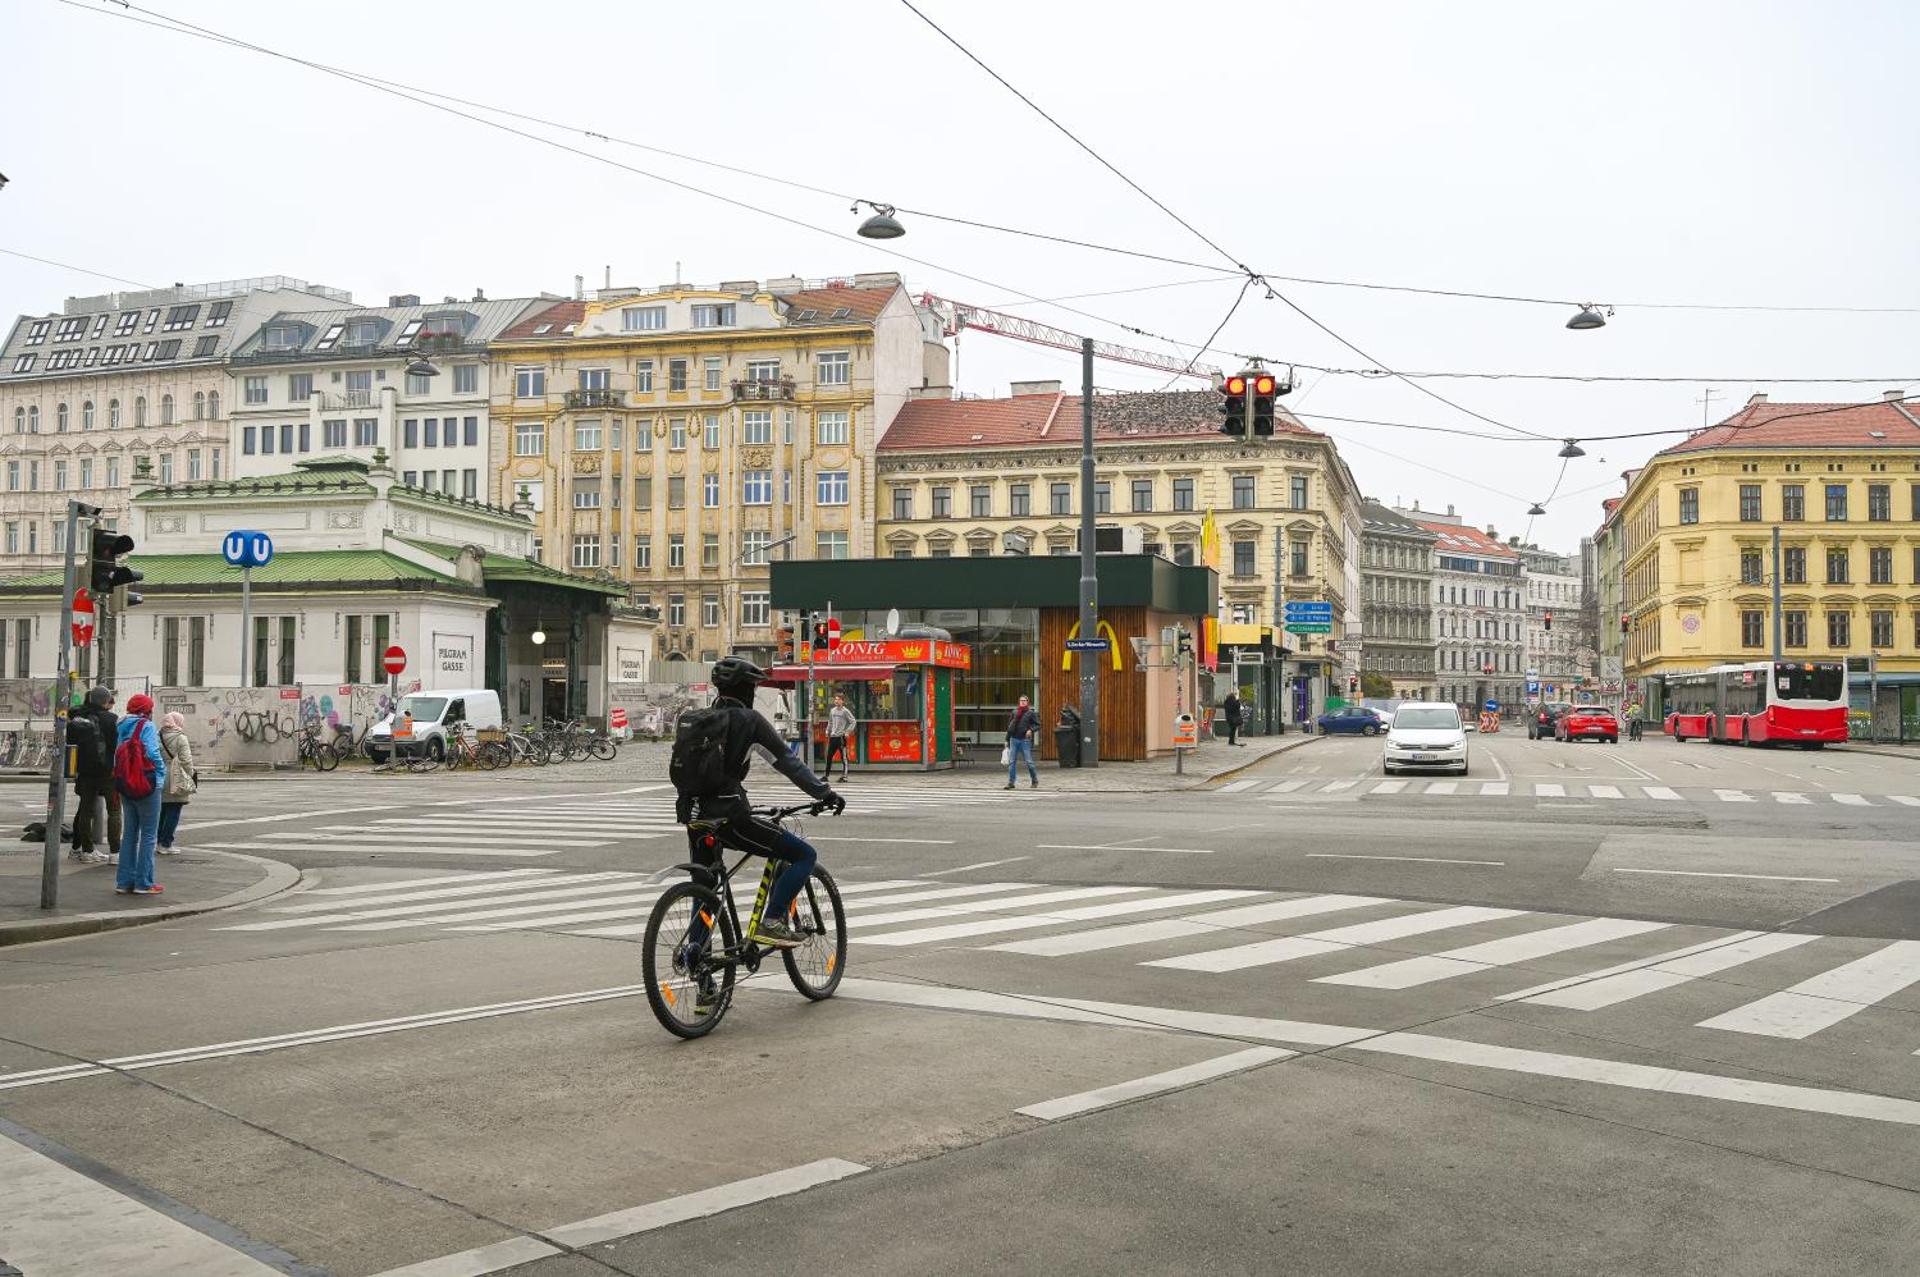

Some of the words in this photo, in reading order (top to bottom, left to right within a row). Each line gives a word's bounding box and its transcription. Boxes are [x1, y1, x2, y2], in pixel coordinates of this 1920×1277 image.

[226, 537, 244, 560] U
[253, 538, 270, 561] U
[438, 648, 467, 660] PILGRAM
[442, 661, 465, 672] GASSE
